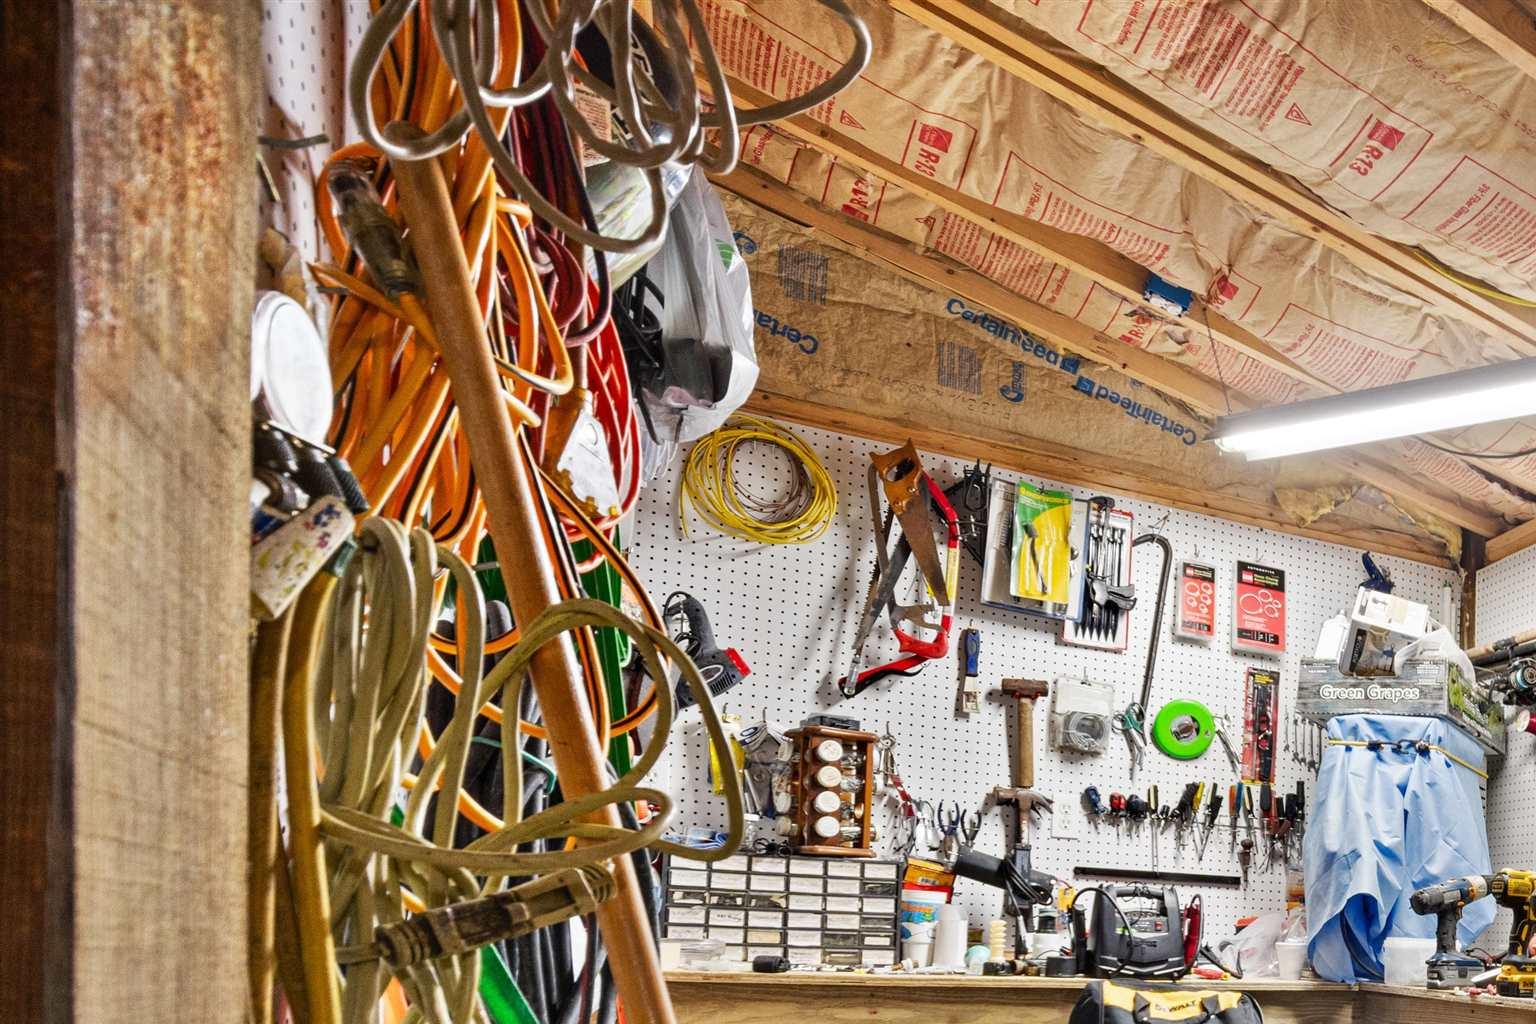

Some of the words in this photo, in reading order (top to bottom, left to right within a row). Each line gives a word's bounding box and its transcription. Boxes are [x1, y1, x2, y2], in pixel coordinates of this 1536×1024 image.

[1095, 387, 1198, 447] CertainTeed
[1320, 684, 1365, 700] Green
[1366, 684, 1420, 703] Grapes
